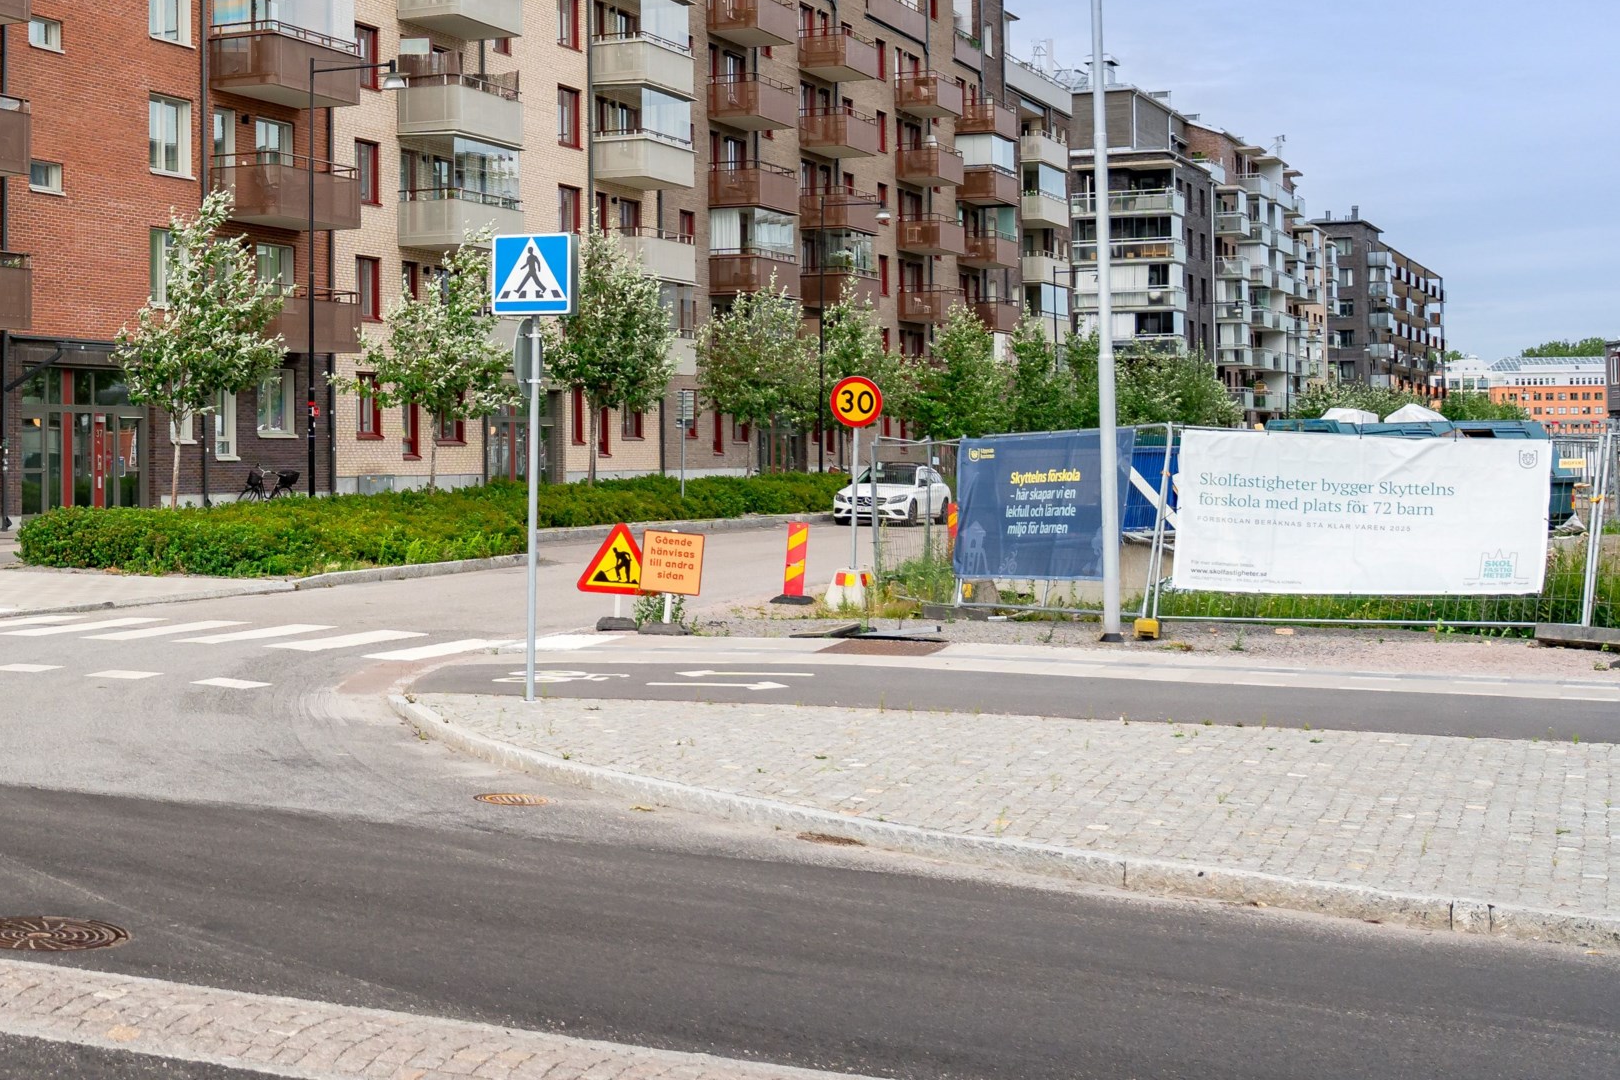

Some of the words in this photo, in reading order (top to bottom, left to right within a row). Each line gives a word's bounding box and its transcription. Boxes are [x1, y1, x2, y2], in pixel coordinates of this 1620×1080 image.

[840, 390, 874, 414] 30
[96, 429, 103, 438] 37
[1010, 470, 1046, 487] Skyttelns
[1046, 468, 1081, 483] förskola
[1199, 472, 1318, 492] Skolfastigheter
[1321, 478, 1374, 496] bygger
[1378, 481, 1455, 498] Skyttelns
[1015, 488, 1029, 501] här
[1029, 488, 1055, 502] skapar
[1055, 486, 1064, 499] vi
[1064, 489, 1076, 499] en
[1006, 504, 1029, 518] lekfull
[1030, 505, 1044, 517] och
[1044, 504, 1076, 517] lärande
[1199, 492, 1260, 508] förskola
[1265, 497, 1298, 510] med
[1303, 498, 1341, 514] plats
[1346, 499, 1368, 514] för
[1373, 501, 1392, 515] 72
[1396, 501, 1434, 516] barn
[1007, 521, 1028, 537] miljö
[1027, 521, 1040, 536] för
[1040, 522, 1068, 534] barnen
[655, 536, 693, 547] Gående
[650, 547, 695, 559] hänvisas
[650, 558, 662, 567] till
[665, 561, 694, 570] andra
[657, 571, 684, 580] sidan
